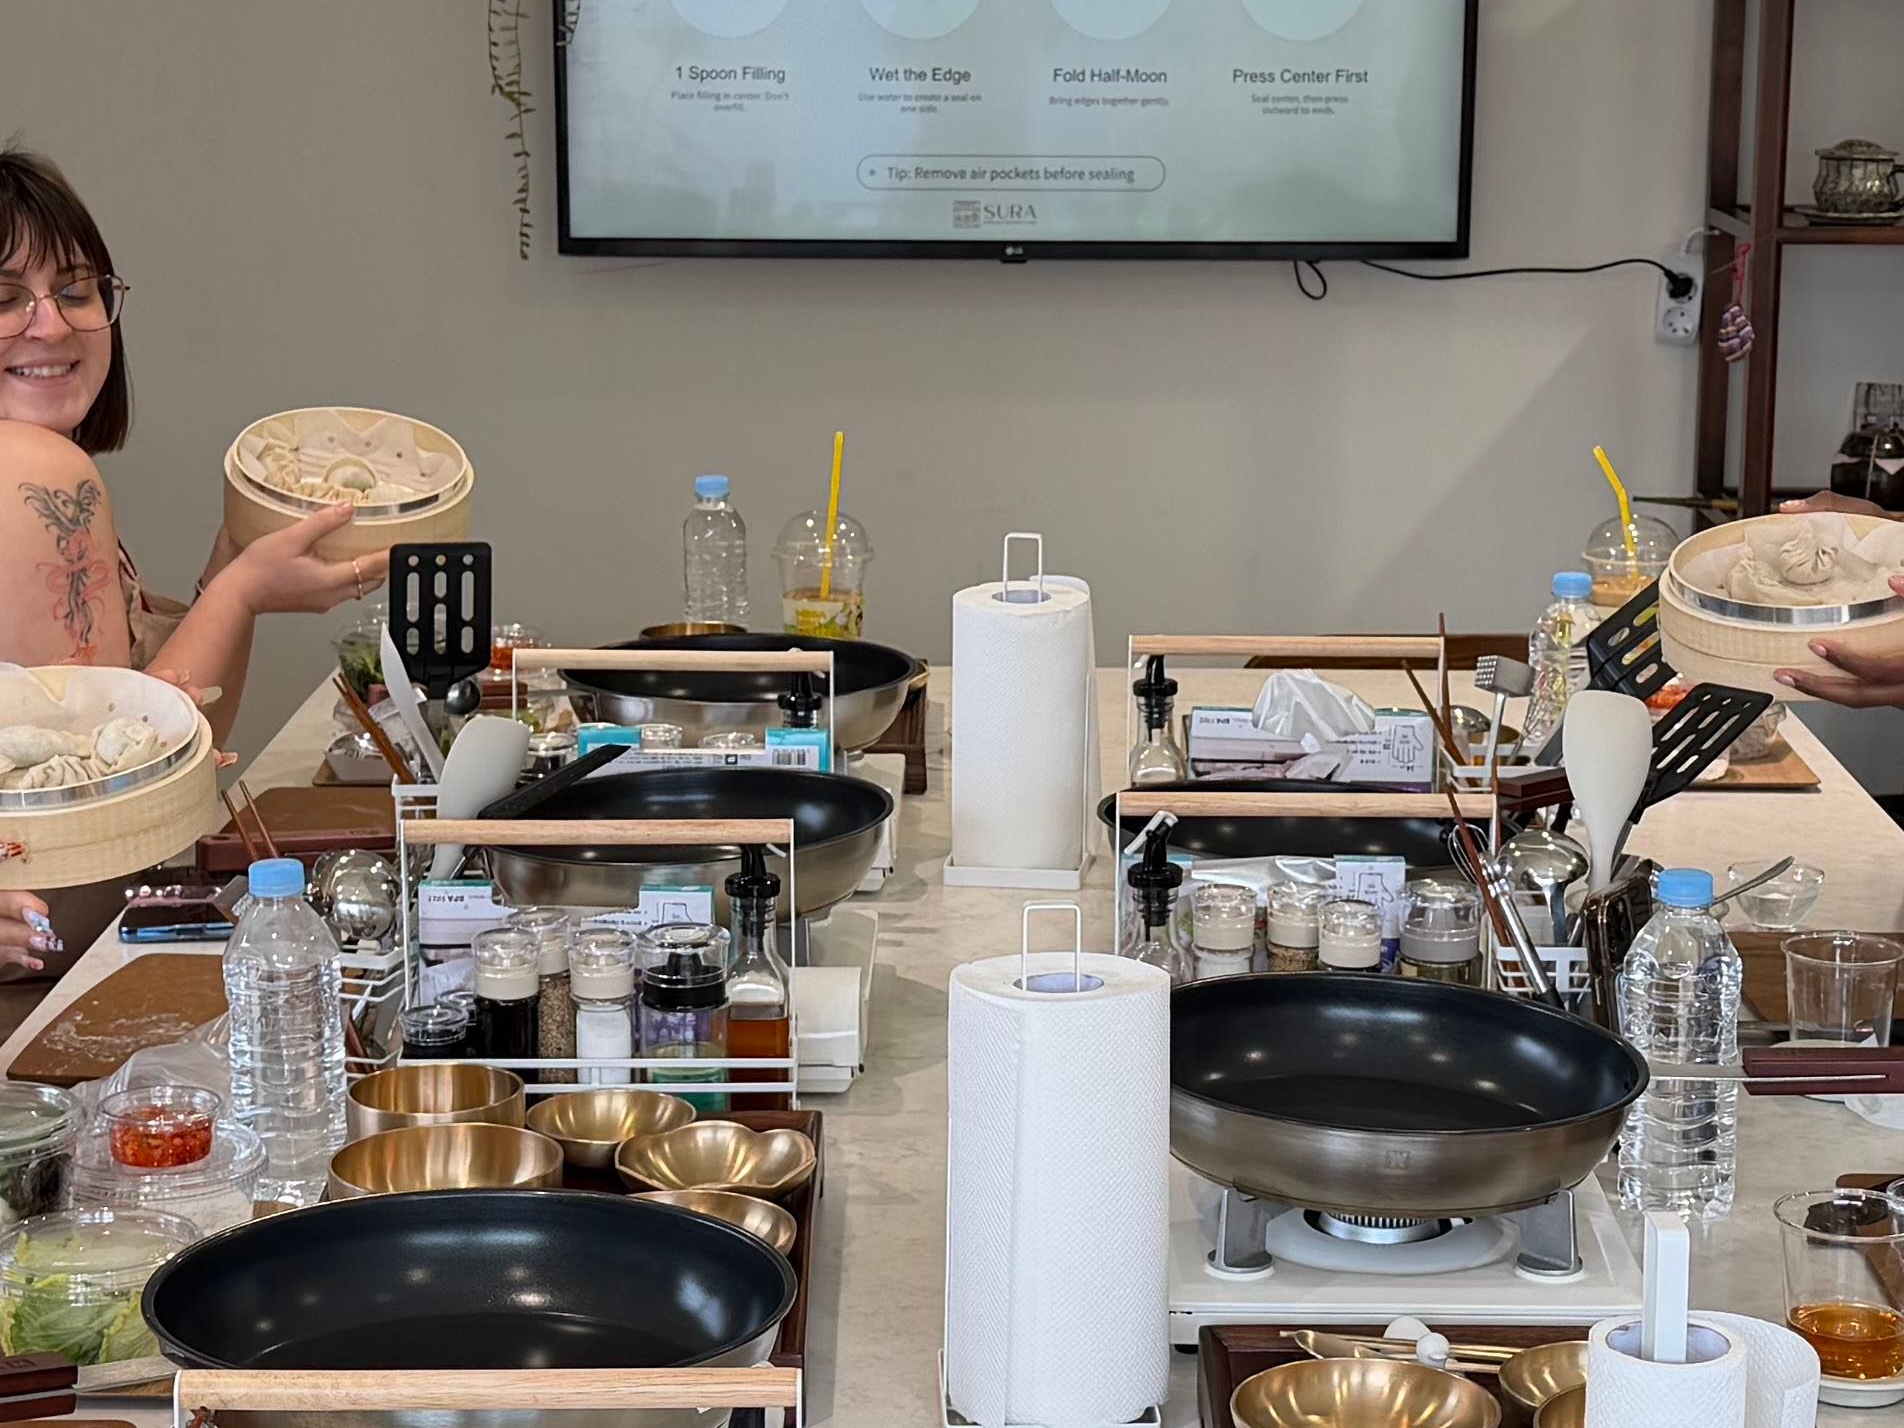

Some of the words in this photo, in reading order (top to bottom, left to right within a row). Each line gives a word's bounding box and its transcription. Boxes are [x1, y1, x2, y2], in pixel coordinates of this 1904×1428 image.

[675, 67, 683, 80] 1
[688, 66, 738, 83] Spoon
[742, 66, 786, 84] Filling
[869, 68, 899, 81] Wet
[902, 67, 928, 81] the
[932, 68, 971, 85] Edge
[1052, 68, 1086, 83] Fold
[1090, 68, 1168, 83] Half-Moon
[1232, 69, 1276, 83] Press
[1280, 69, 1331, 83] Center
[1335, 69, 1369, 83] First
[903, 93, 913, 102] to
[1049, 95, 1073, 107] Bring
[1074, 95, 1100, 107] edges
[1102, 95, 1140, 107] together
[887, 166, 911, 180] Tip:
[914, 166, 967, 180] Remove
[970, 166, 988, 180] air
[990, 166, 1041, 182] pockets
[1043, 167, 1086, 181] before
[1089, 167, 1135, 184] sealing
[983, 204, 1037, 220] SURA
